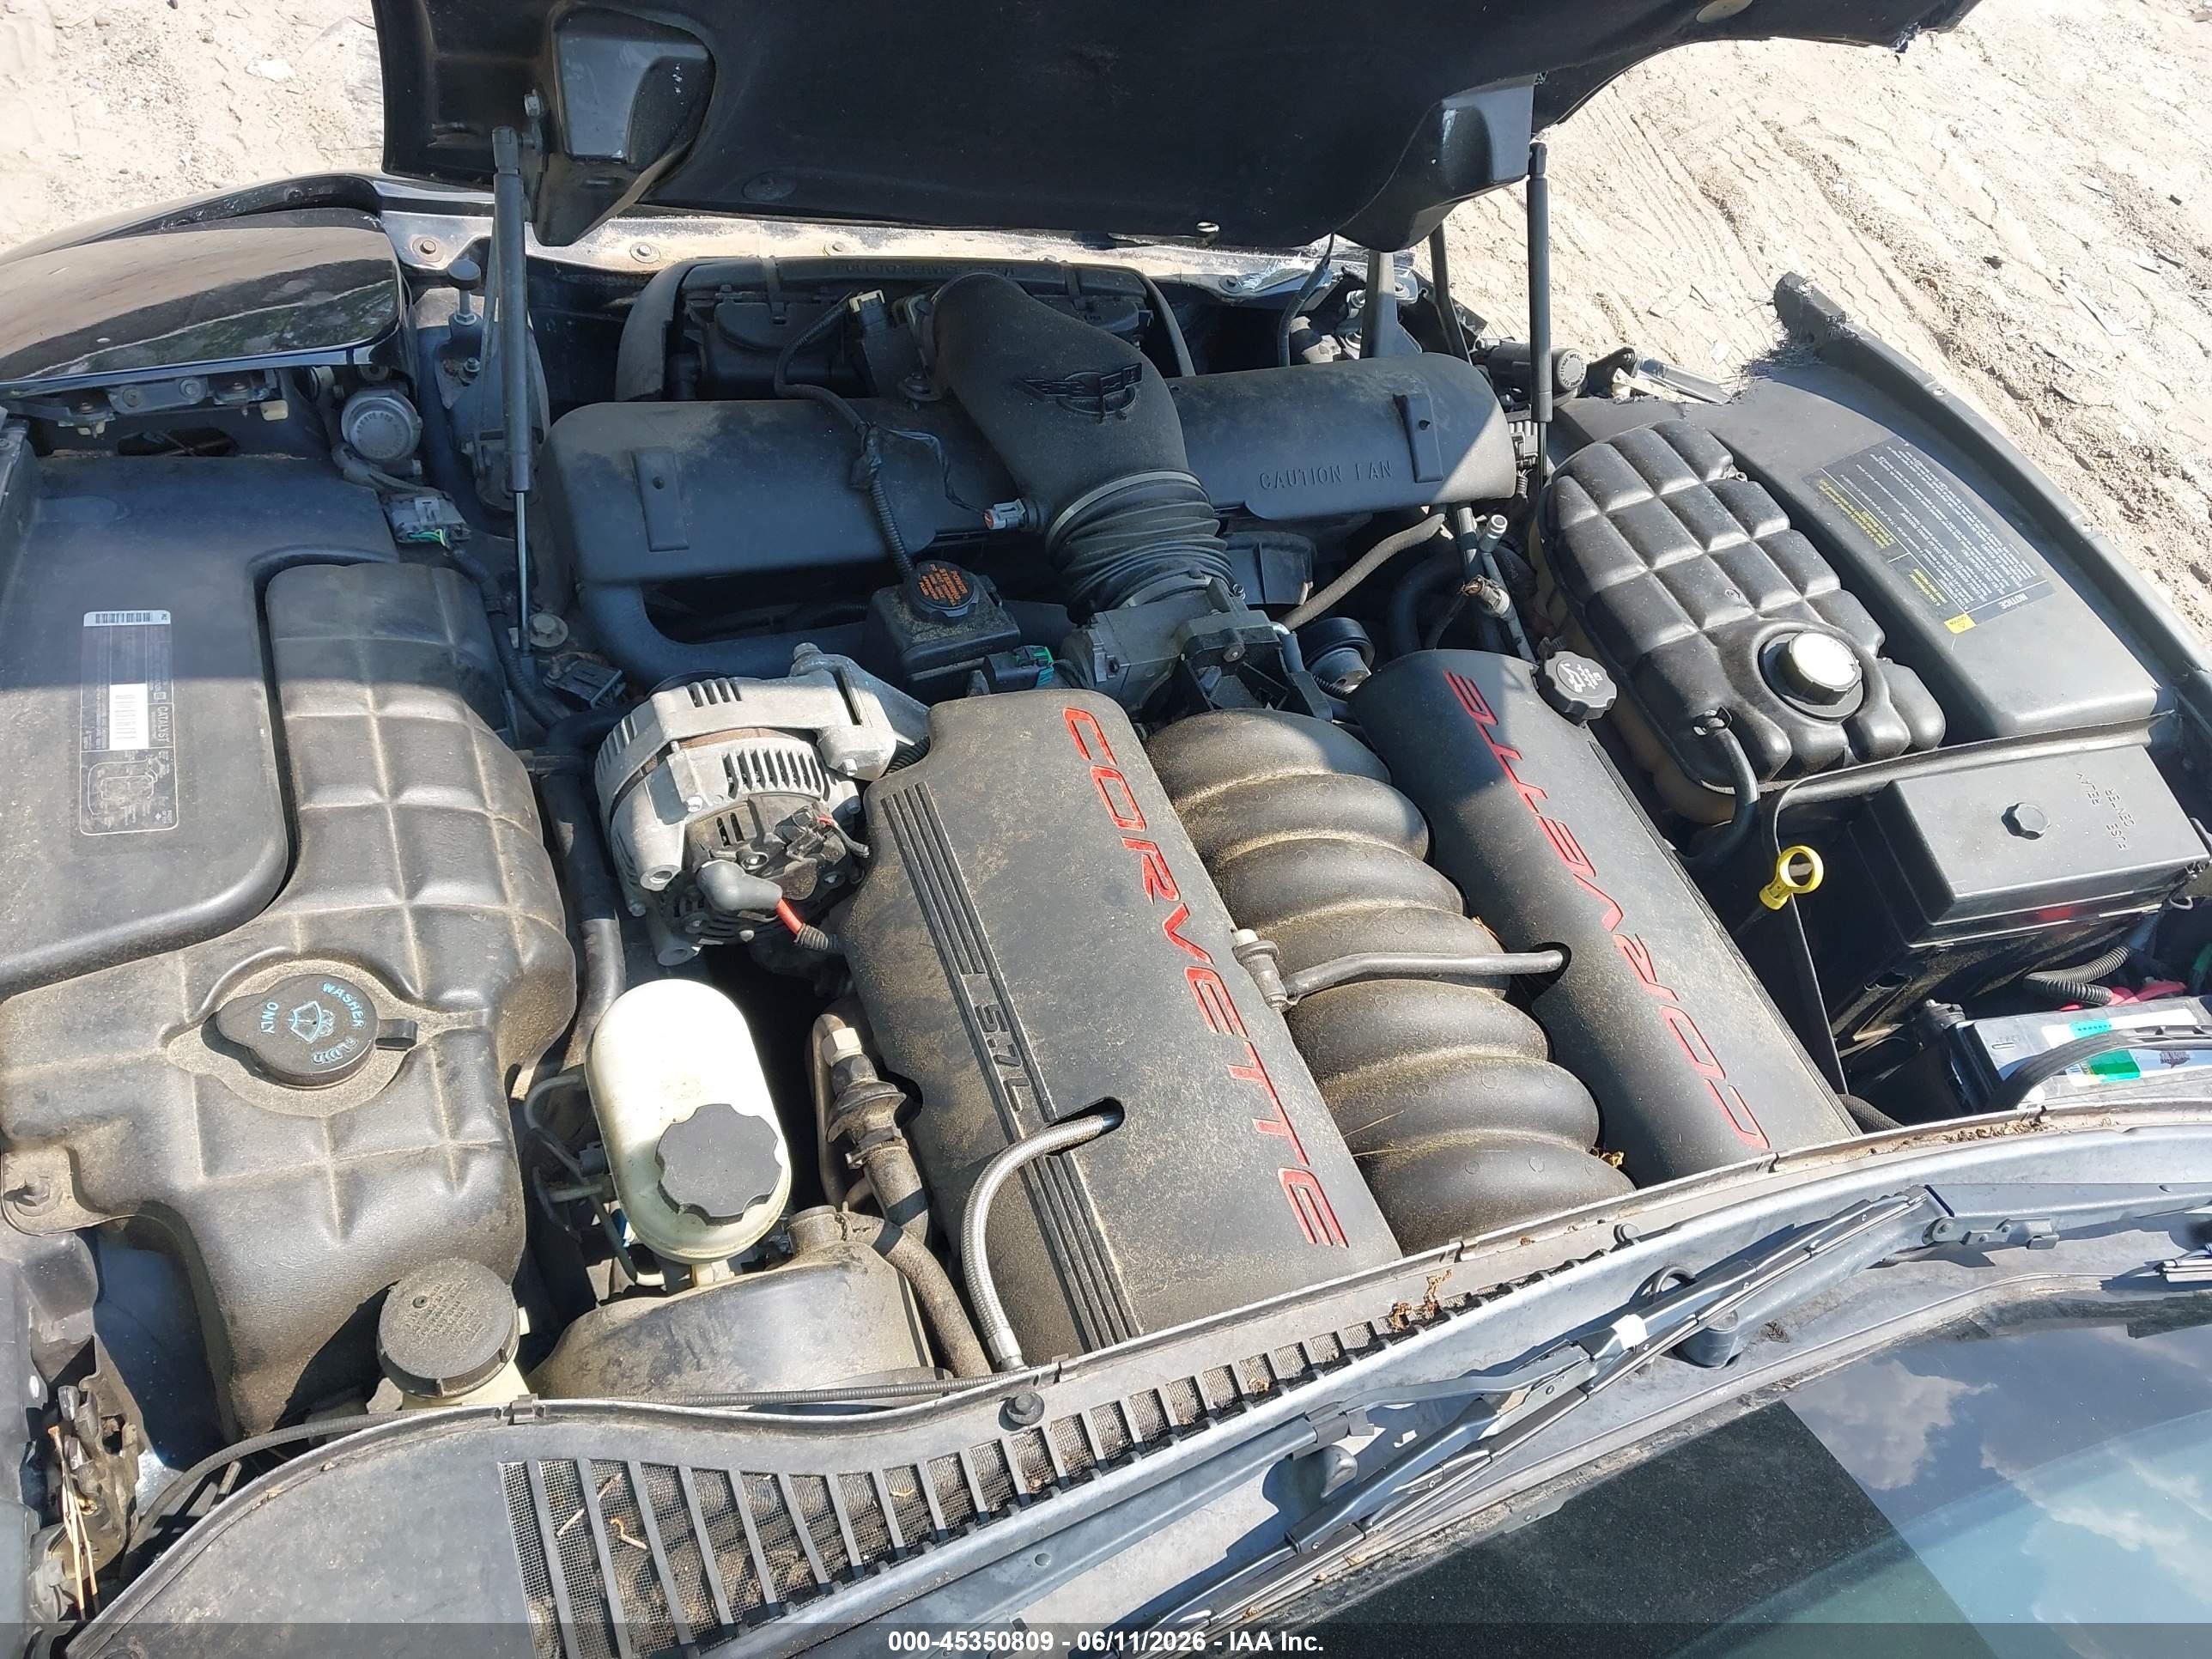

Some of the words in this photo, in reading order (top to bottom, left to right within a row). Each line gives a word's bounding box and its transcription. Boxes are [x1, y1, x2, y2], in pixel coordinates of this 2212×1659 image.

[1260, 465, 1342, 490] CAUTION
[939, 568, 961, 599] STEERING
[951, 570, 969, 594] POWER
[2001, 593, 2028, 610] NOTICE
[156, 705, 170, 744] CATALYST
[1442, 669, 1771, 1150] CORVETTE
[1062, 707, 1349, 1249] CORVETTE
[260, 1001, 278, 1035] ONLY
[323, 981, 367, 1029] WASHER
[312, 1037, 359, 1065] FLUID
[974, 1003, 1034, 1115] 5.7L
